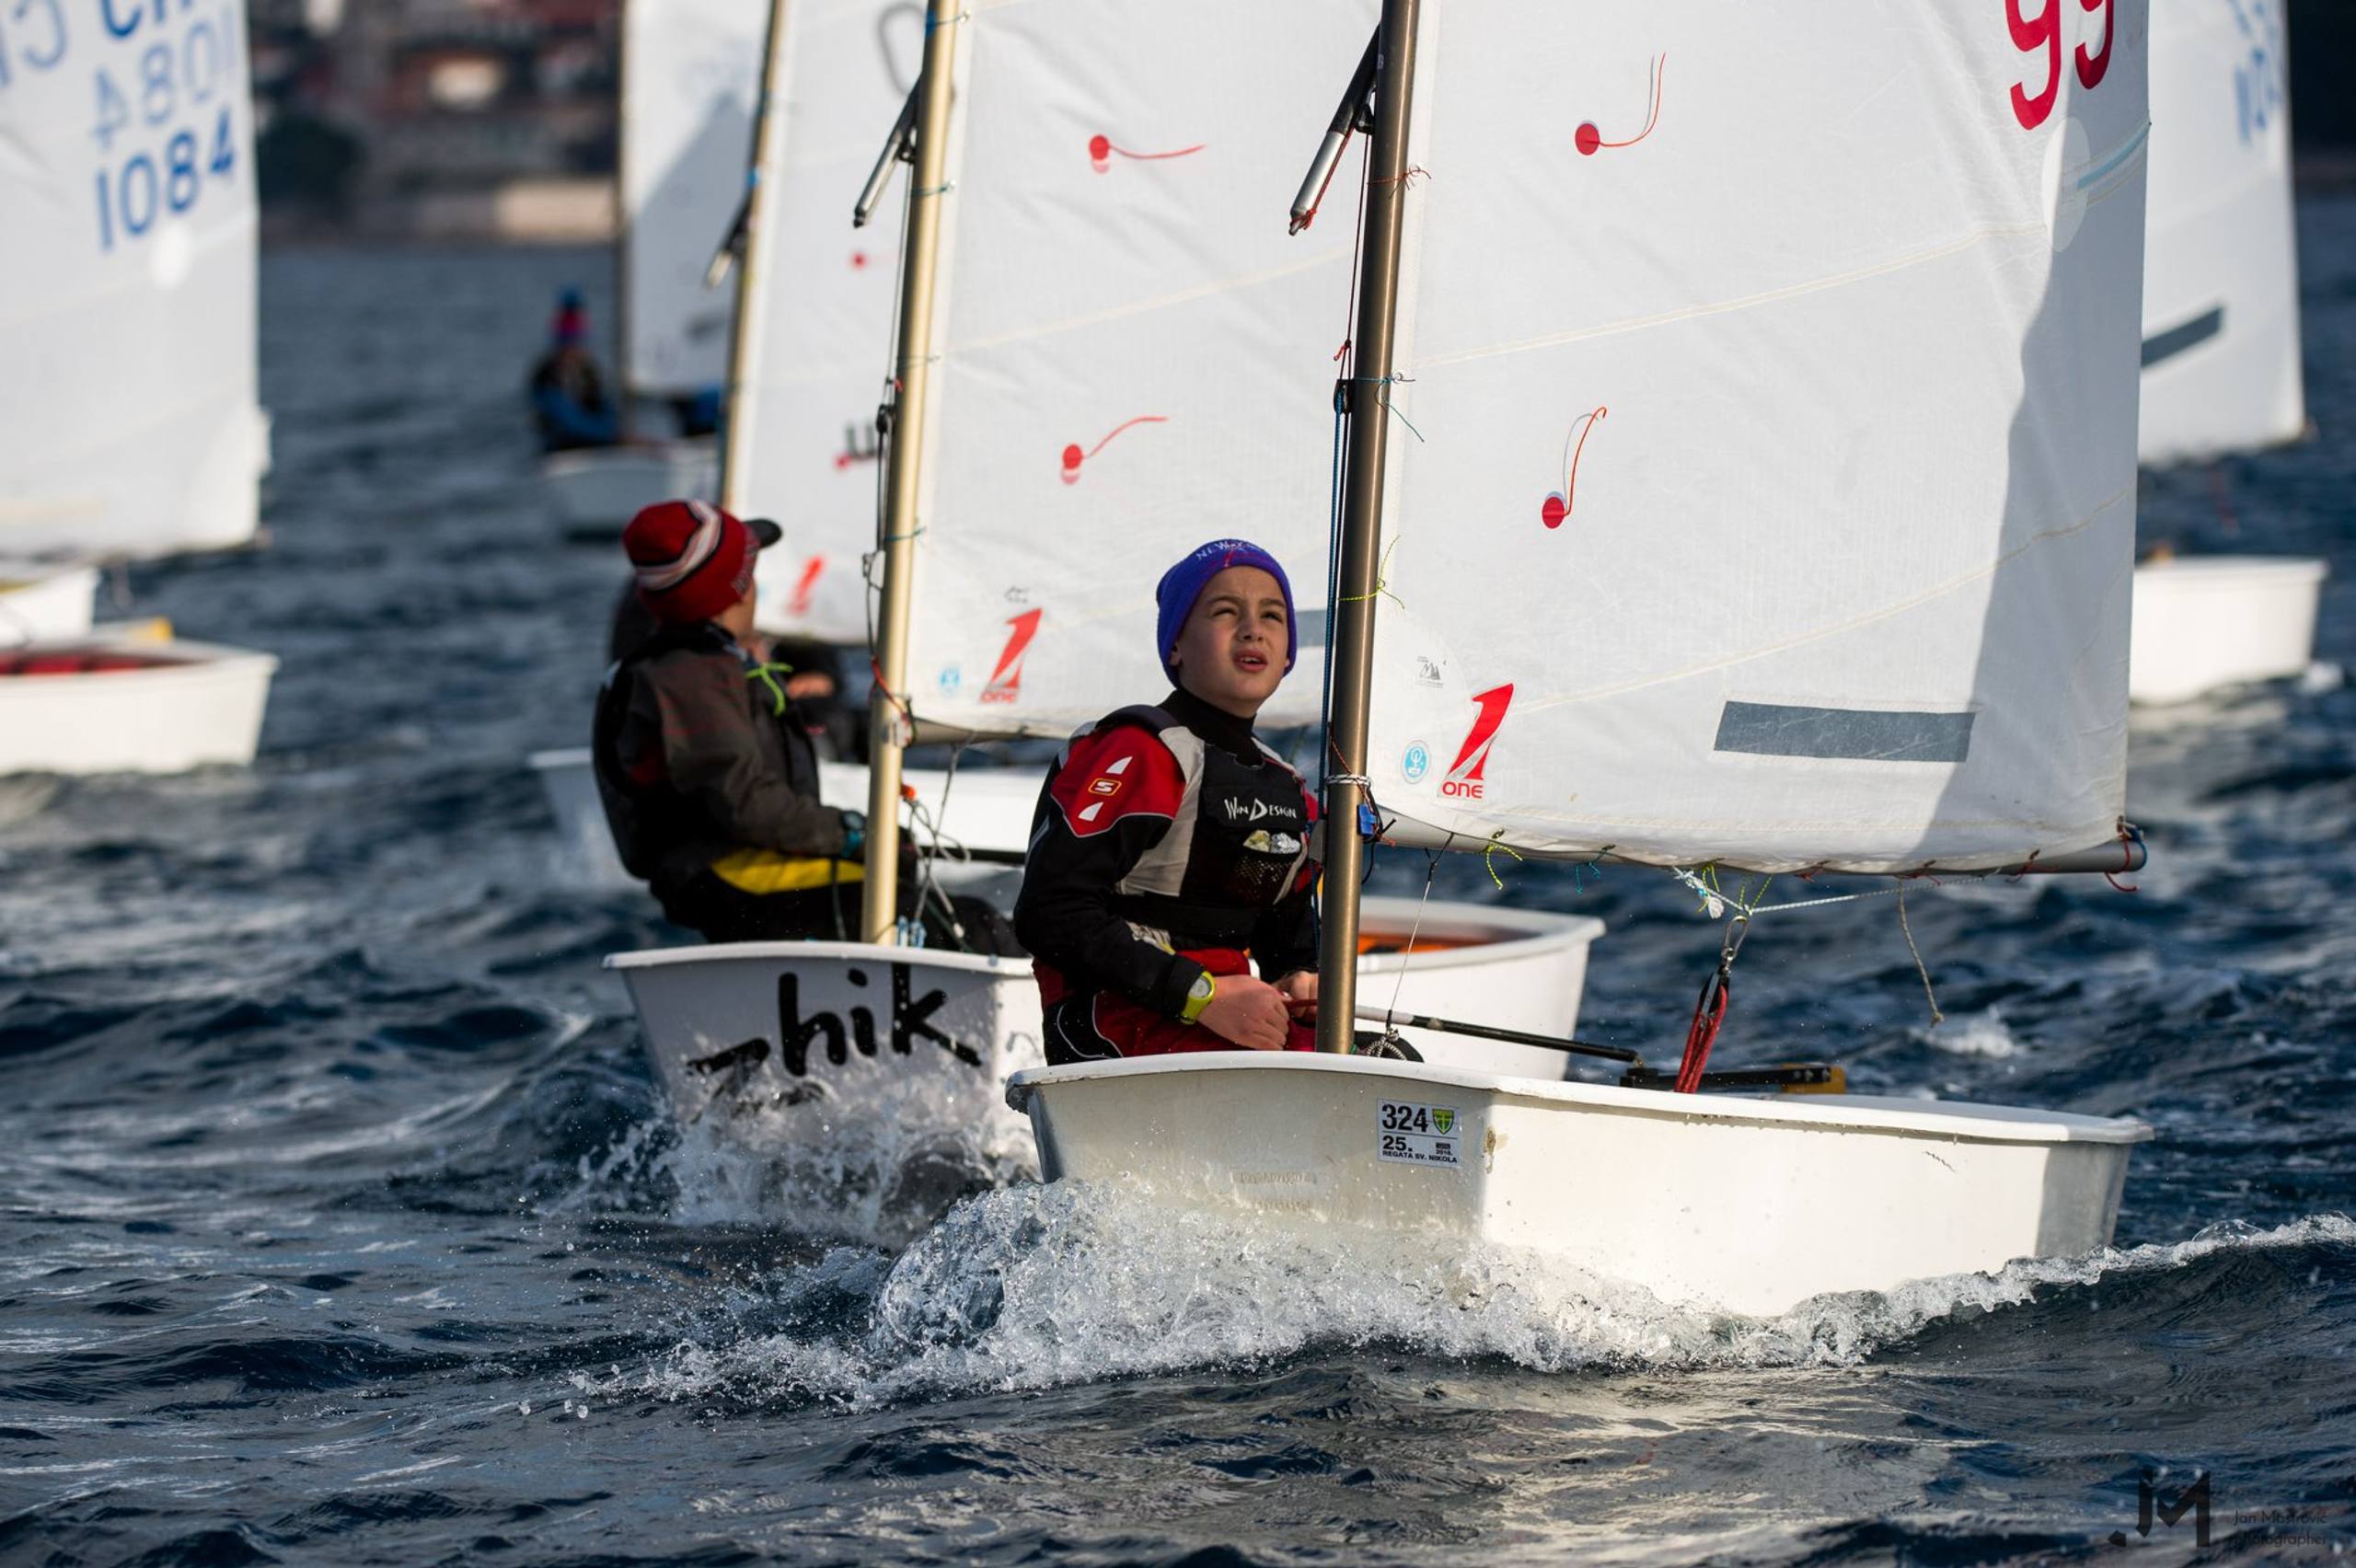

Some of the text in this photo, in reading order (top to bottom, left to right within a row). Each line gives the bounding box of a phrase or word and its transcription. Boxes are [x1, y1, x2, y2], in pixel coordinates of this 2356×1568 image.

[95, 106, 237, 251] 1084
[1381, 1103, 1428, 1133] 324
[1382, 1136, 1414, 1152] 25.
[1382, 1150, 1414, 1159] REGATA
[1428, 1155, 1458, 1164] NIKOLA
